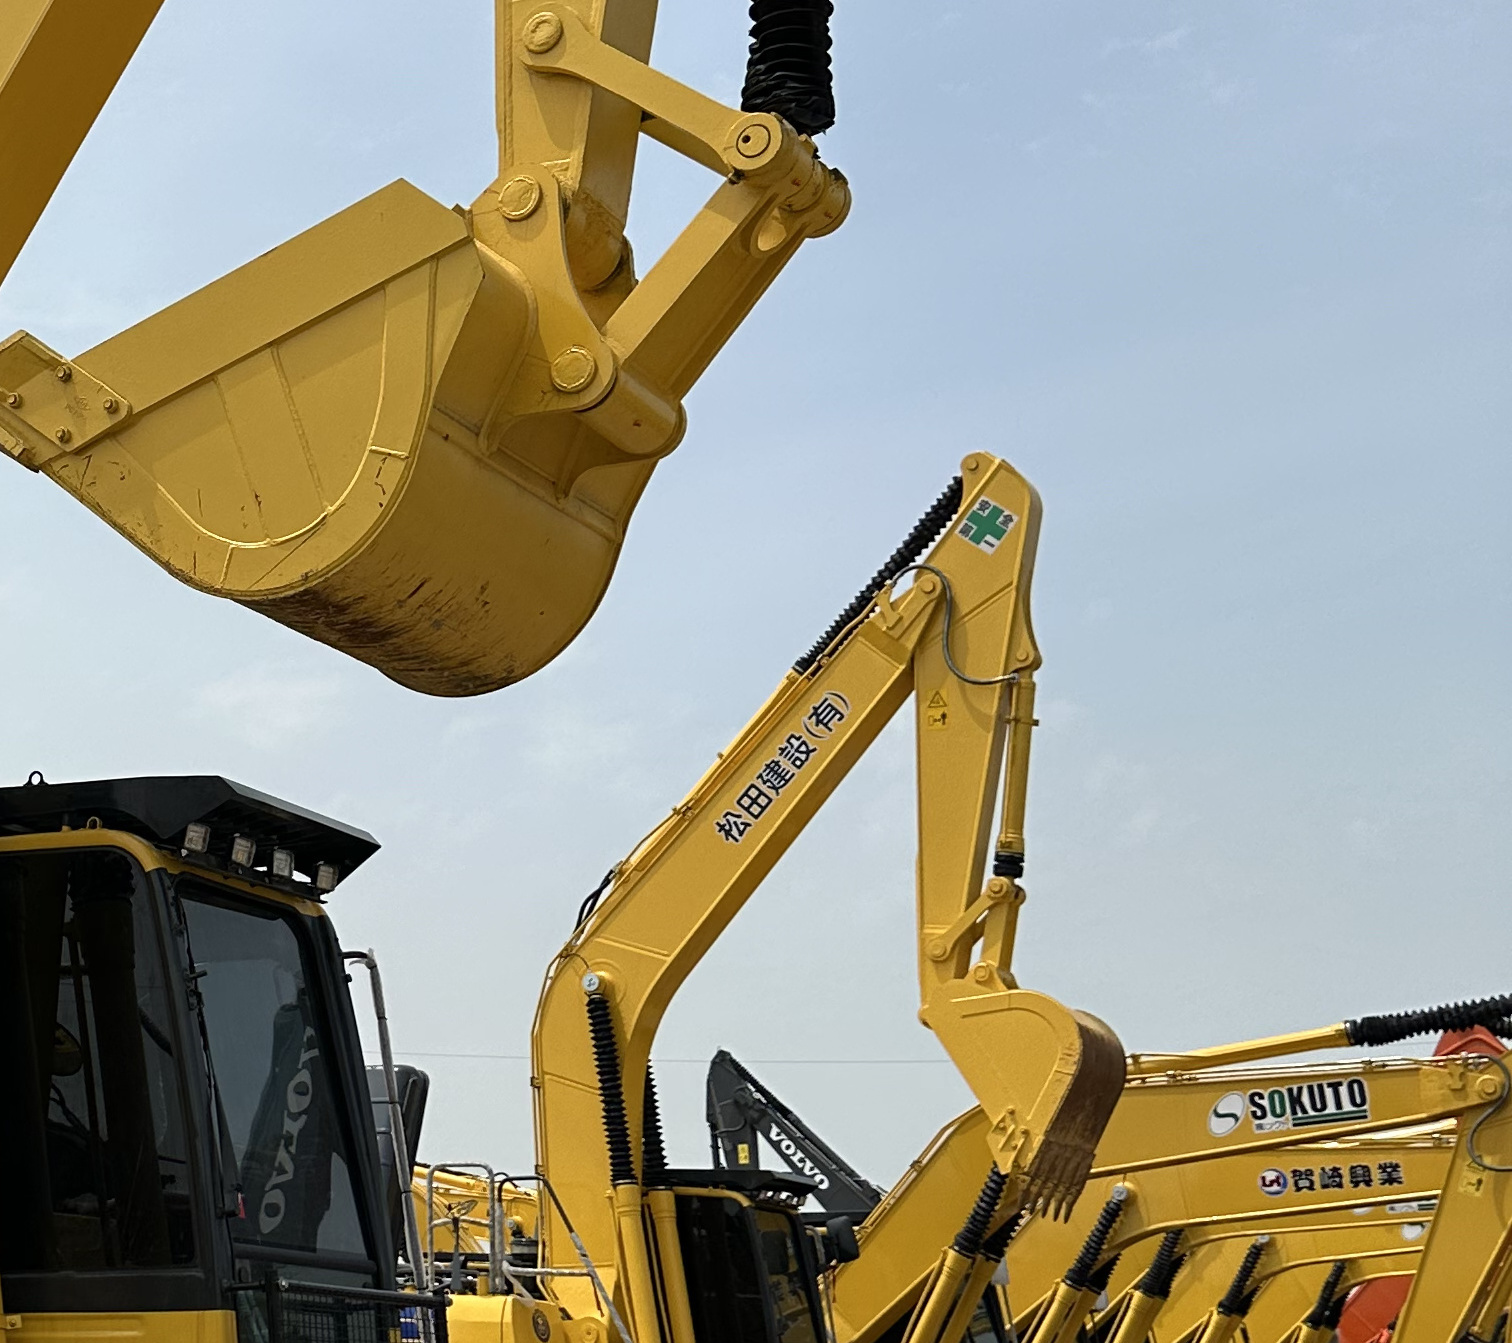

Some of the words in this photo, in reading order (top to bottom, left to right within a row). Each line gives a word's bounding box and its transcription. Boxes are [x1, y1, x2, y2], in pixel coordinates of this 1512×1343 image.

[715, 691, 849, 843] 松田建設(有)
[1248, 1078, 1368, 1121] SOKUTO
[769, 1123, 830, 1190] VOLVO
